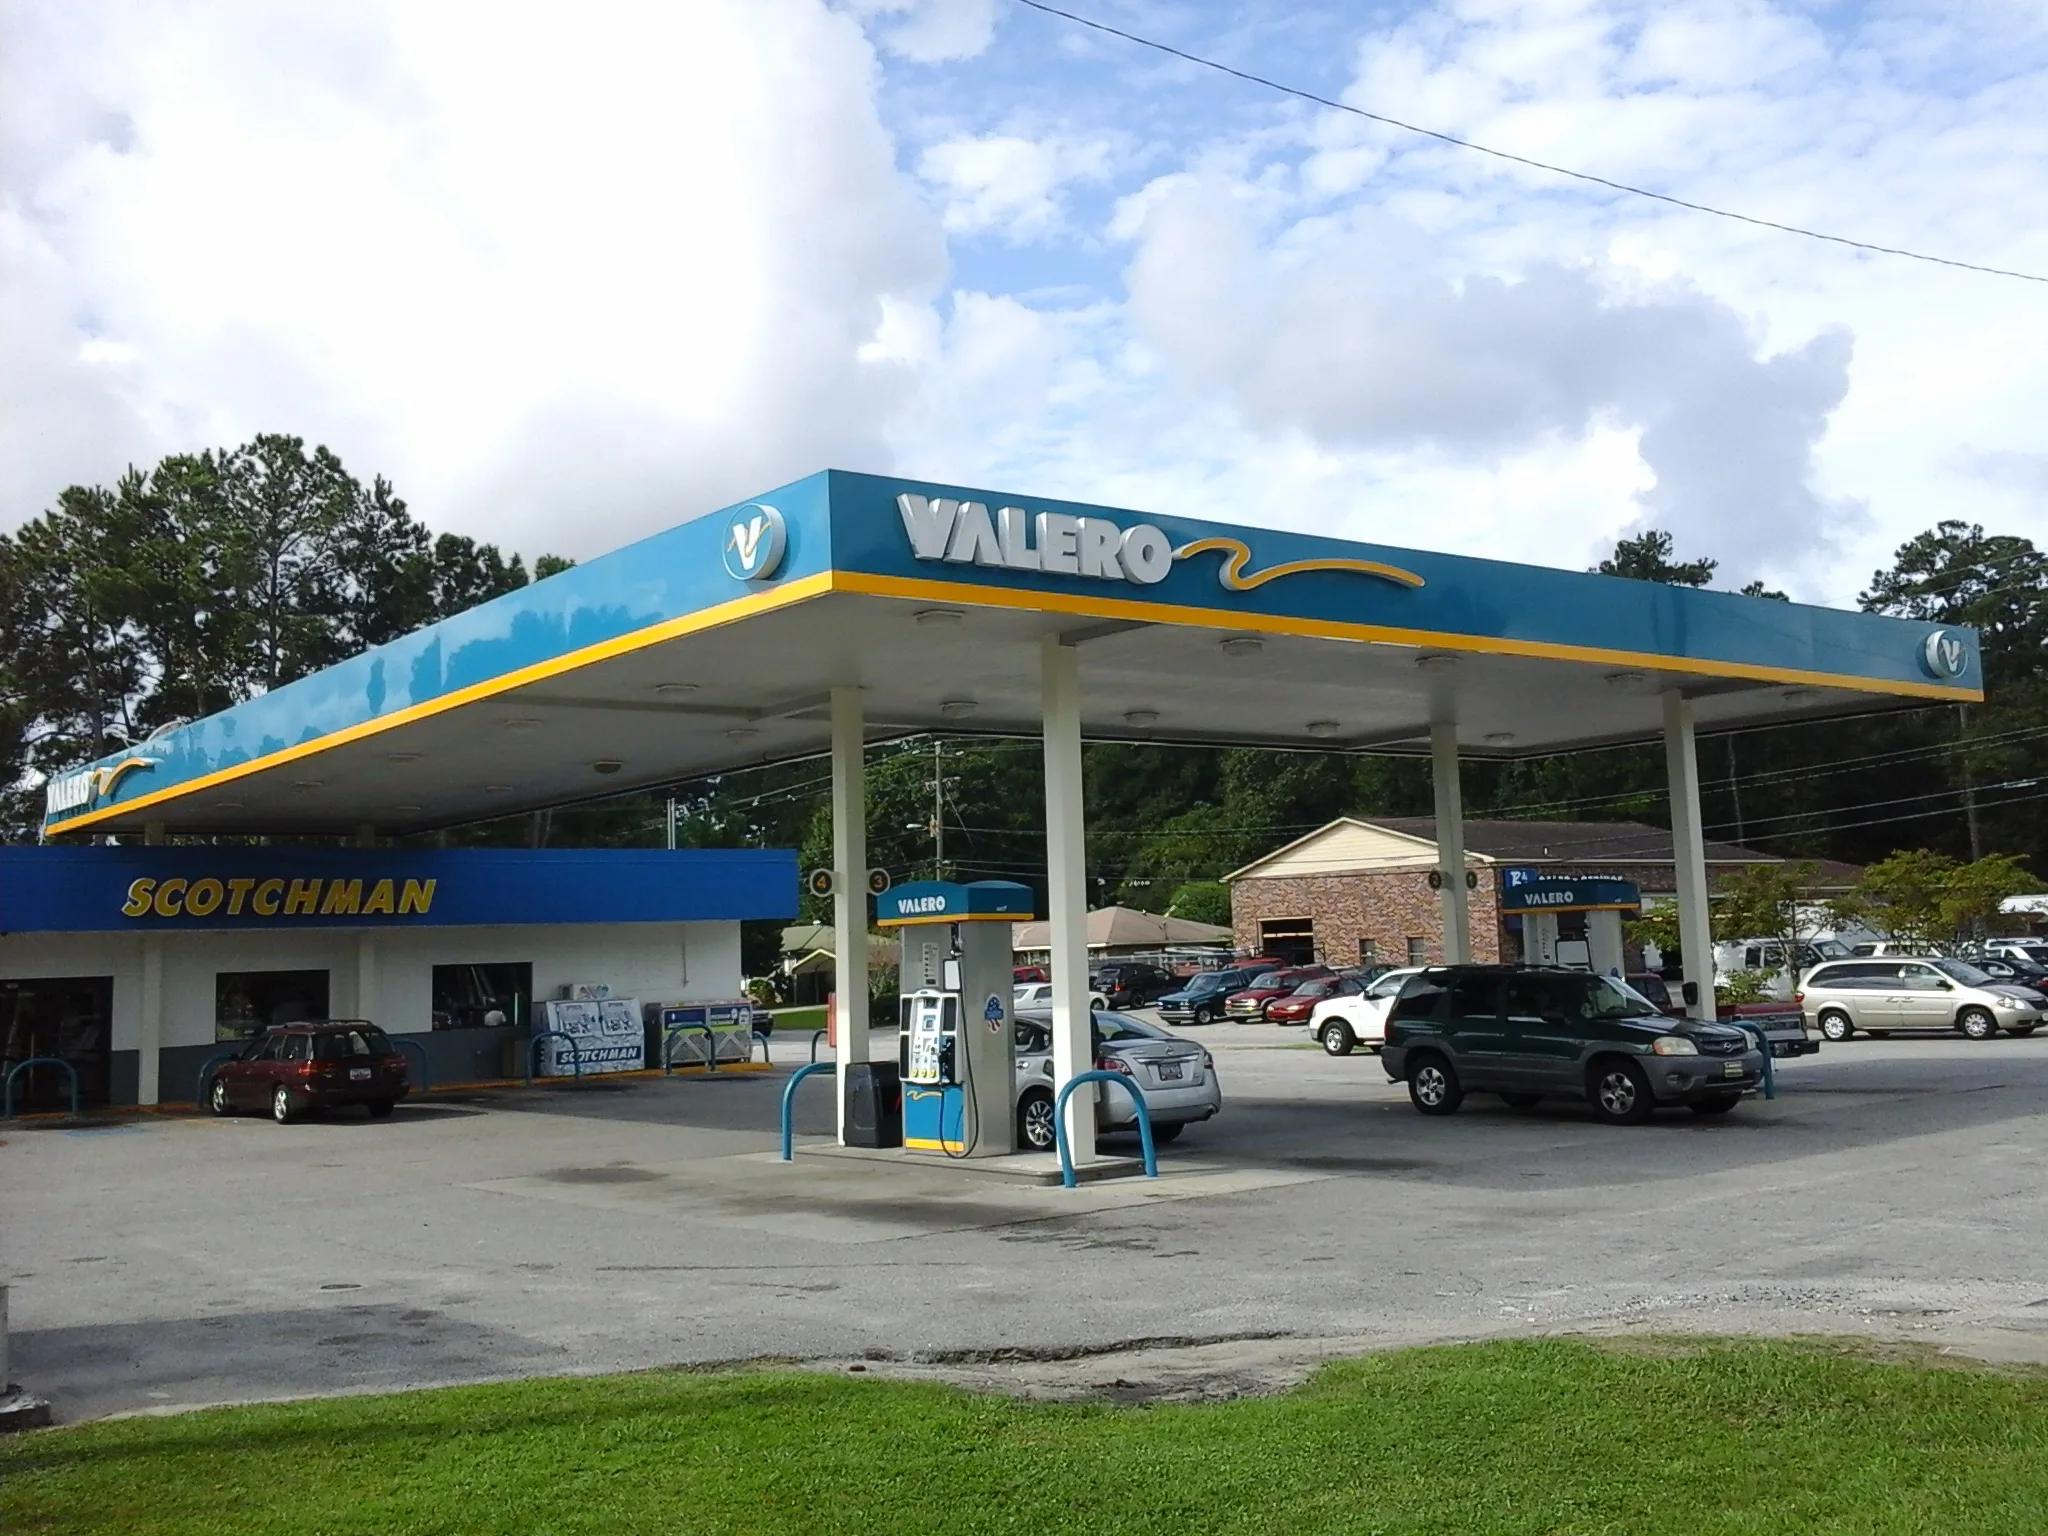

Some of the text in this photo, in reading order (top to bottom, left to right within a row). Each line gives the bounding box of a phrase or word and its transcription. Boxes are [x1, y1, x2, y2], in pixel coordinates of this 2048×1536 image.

[732, 515, 763, 572] V
[895, 493, 1173, 584] VALERO
[47, 772, 95, 813] VALERO
[122, 877, 437, 917] SCOTCHMAN
[897, 895, 946, 914] VALERO
[1525, 891, 1574, 905] VALERO
